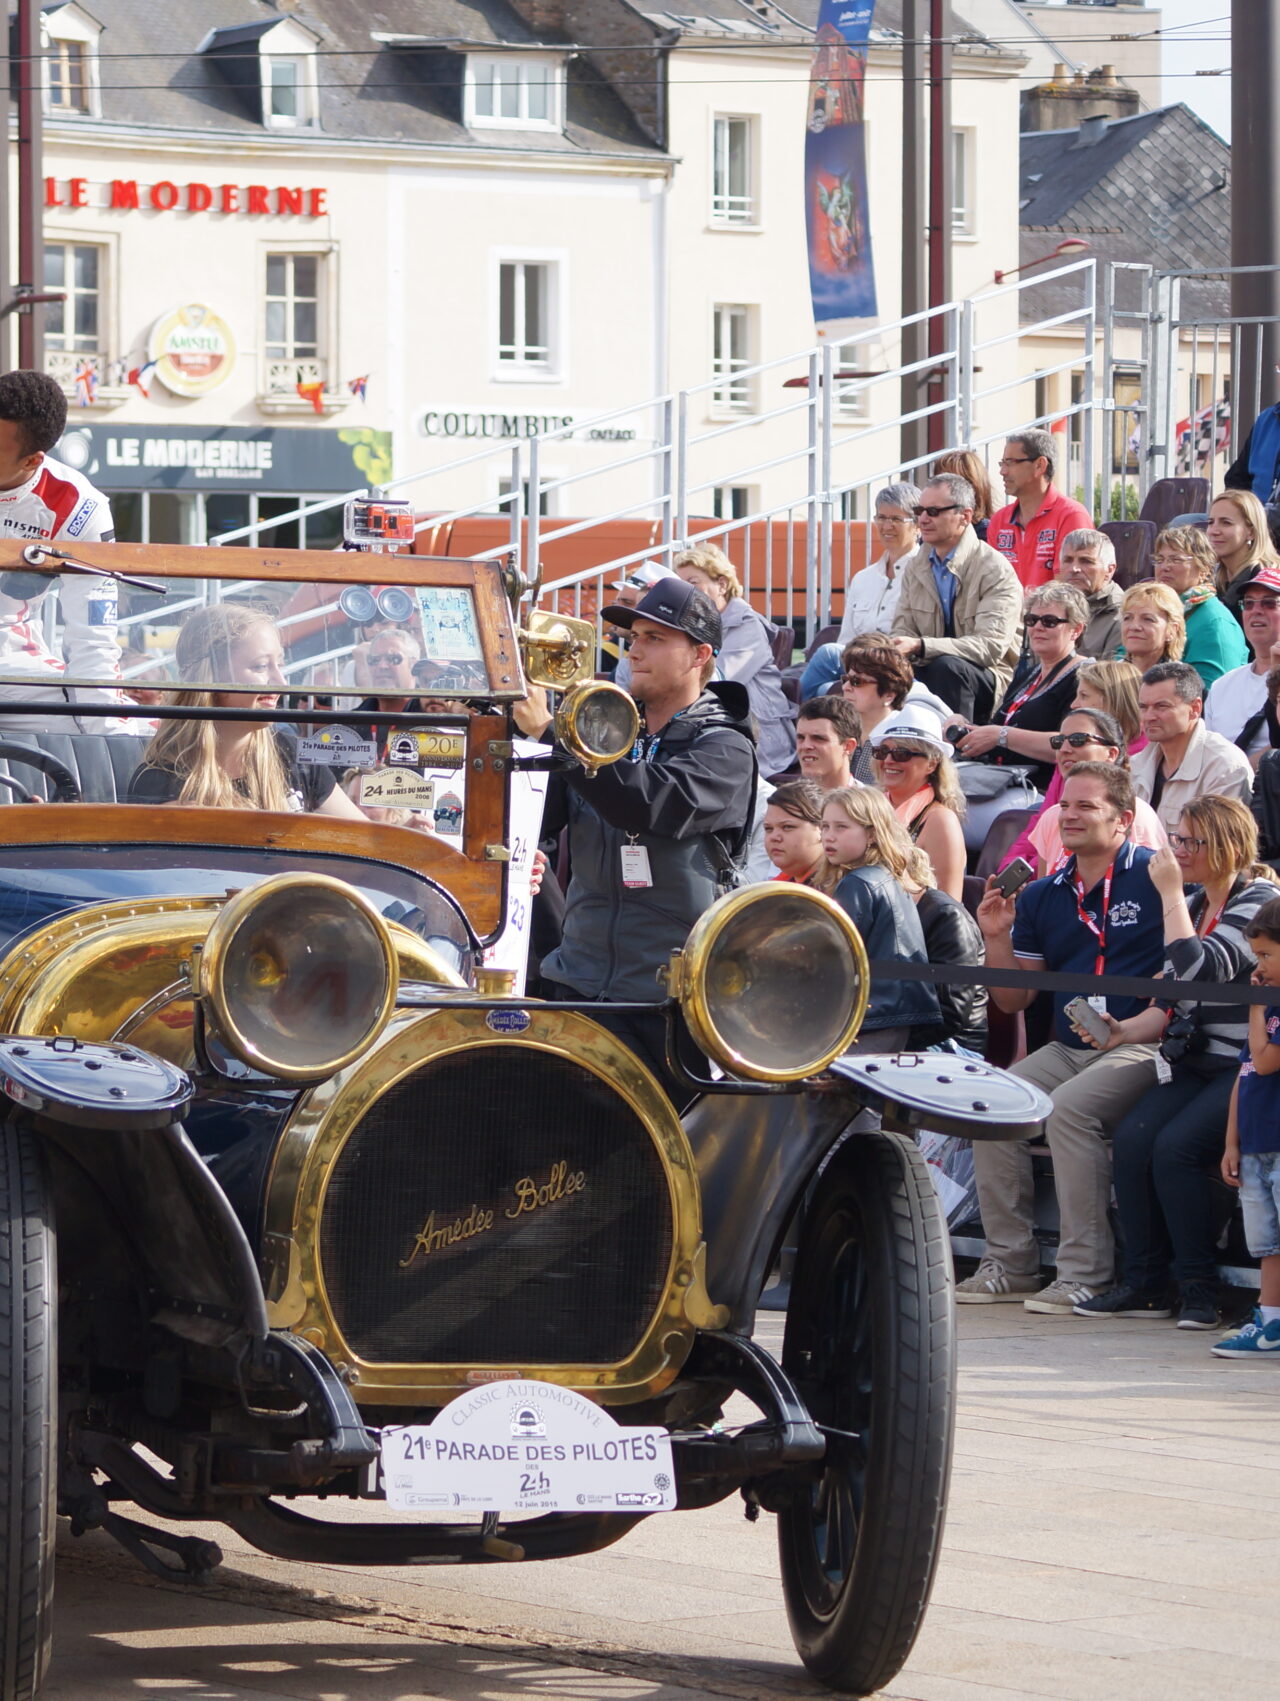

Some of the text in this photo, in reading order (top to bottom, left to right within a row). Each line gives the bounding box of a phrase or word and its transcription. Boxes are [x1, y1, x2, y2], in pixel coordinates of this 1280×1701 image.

[45, 177, 329, 217] LE MODERNE
[424, 411, 575, 439] COLUMBUS
[106, 438, 273, 469] LE MODERNE
[70, 500, 96, 533] sparco
[3, 519, 51, 538] nismo
[313, 743, 335, 751] PARADE
[347, 745, 371, 753] PILOTES
[364, 784, 384, 798] 24
[451, 1384, 602, 1429] CLASSIC AUTOMOTIVE
[435, 1439, 519, 1461] PARADE
[526, 1445, 567, 1461] DES
[573, 1433, 658, 1461] PILOTES
[525, 1463, 539, 1471] DES
[530, 1488, 551, 1497] MANS
[525, 1501, 539, 1509] juin
